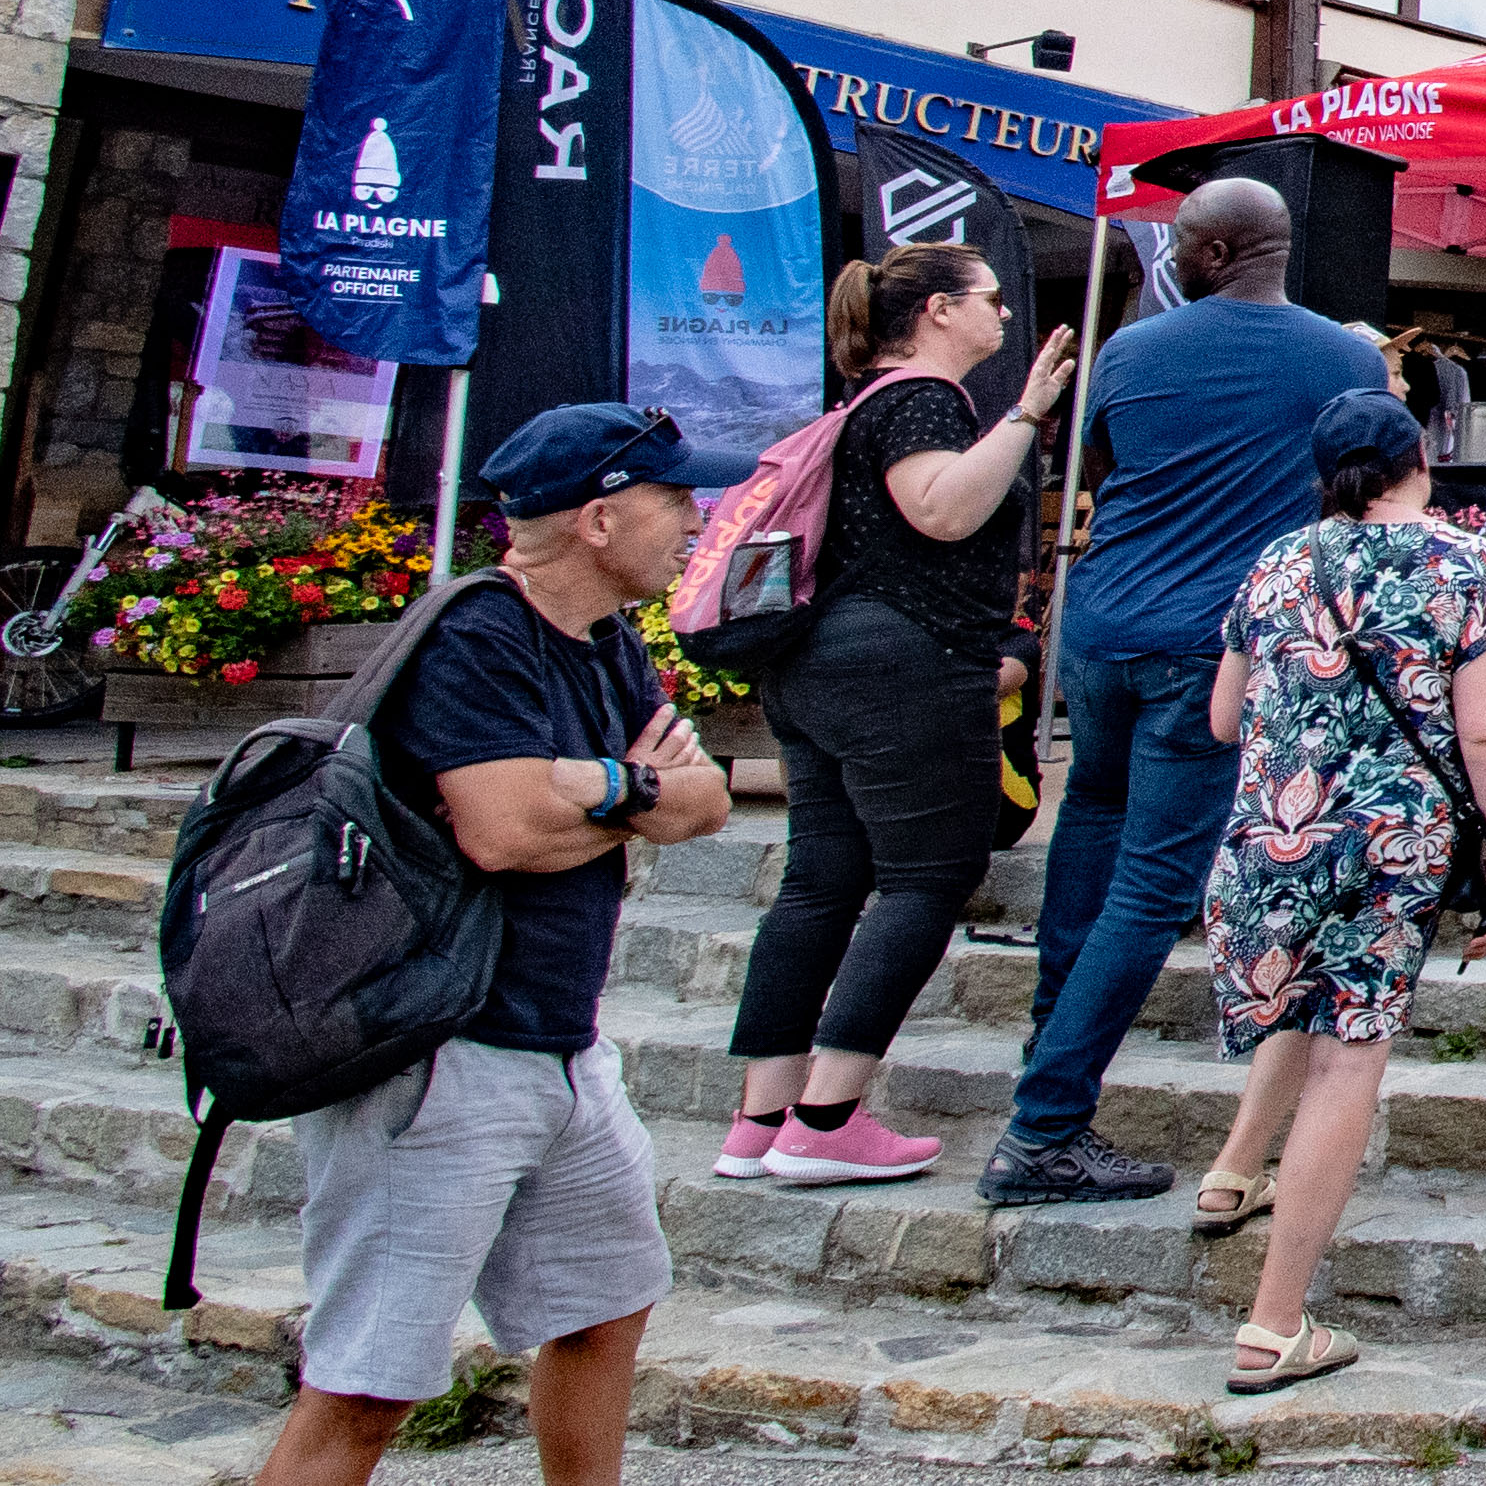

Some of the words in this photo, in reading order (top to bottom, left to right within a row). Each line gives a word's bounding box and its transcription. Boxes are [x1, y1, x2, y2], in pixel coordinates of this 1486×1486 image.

[793, 62, 1098, 165] TRUCTEUR
[1272, 100, 1313, 135] LA
[1320, 81, 1448, 124] PLAGNE
[1356, 126, 1376, 144] EN
[1379, 121, 1436, 142] VANOISE
[313, 210, 340, 231] LA
[342, 213, 448, 237] PLAGNE
[322, 263, 421, 283] PARTENAIRE
[330, 280, 404, 297] OFFICIEL
[671, 475, 779, 615] adidas
